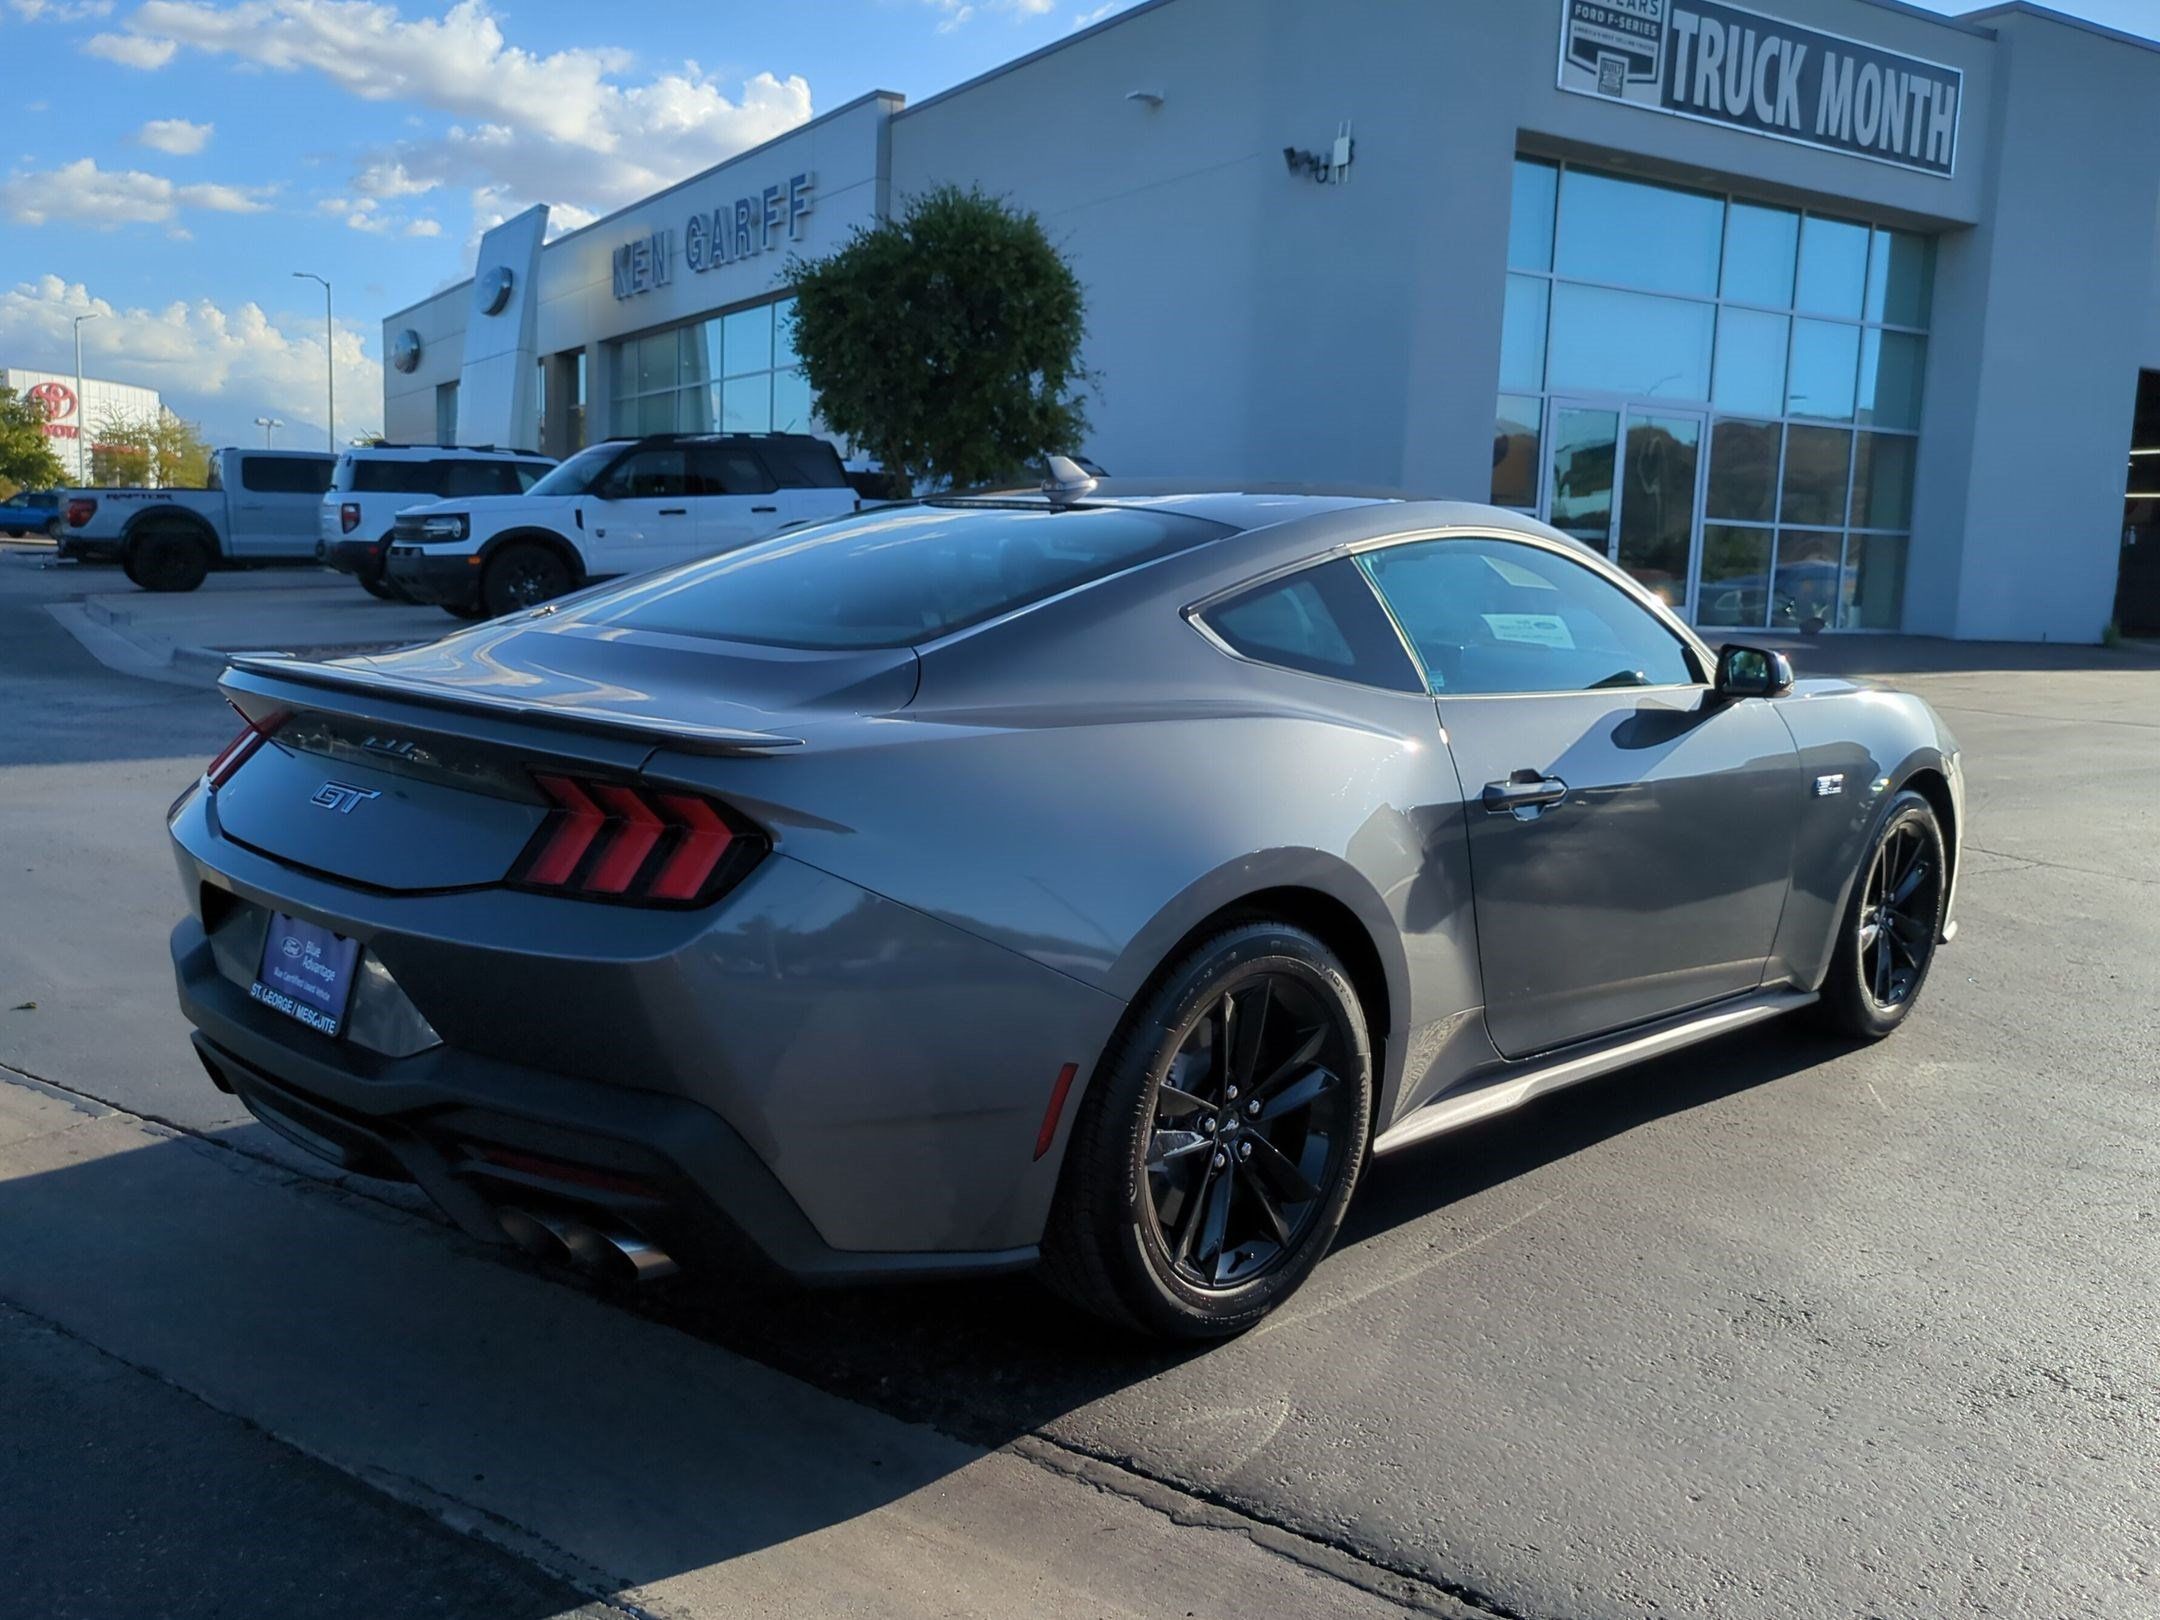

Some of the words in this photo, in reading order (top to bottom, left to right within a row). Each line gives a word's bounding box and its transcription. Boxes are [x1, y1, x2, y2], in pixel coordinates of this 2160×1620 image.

[1575, 4, 1604, 22] FORD
[1607, 13, 1657, 37] F-SERIES
[1672, 8, 1808, 130] TRUCK
[1815, 52, 1955, 165] MONTH
[613, 230, 671, 300] KEN
[686, 173, 812, 273] GARFF
[311, 780, 382, 814] GT
